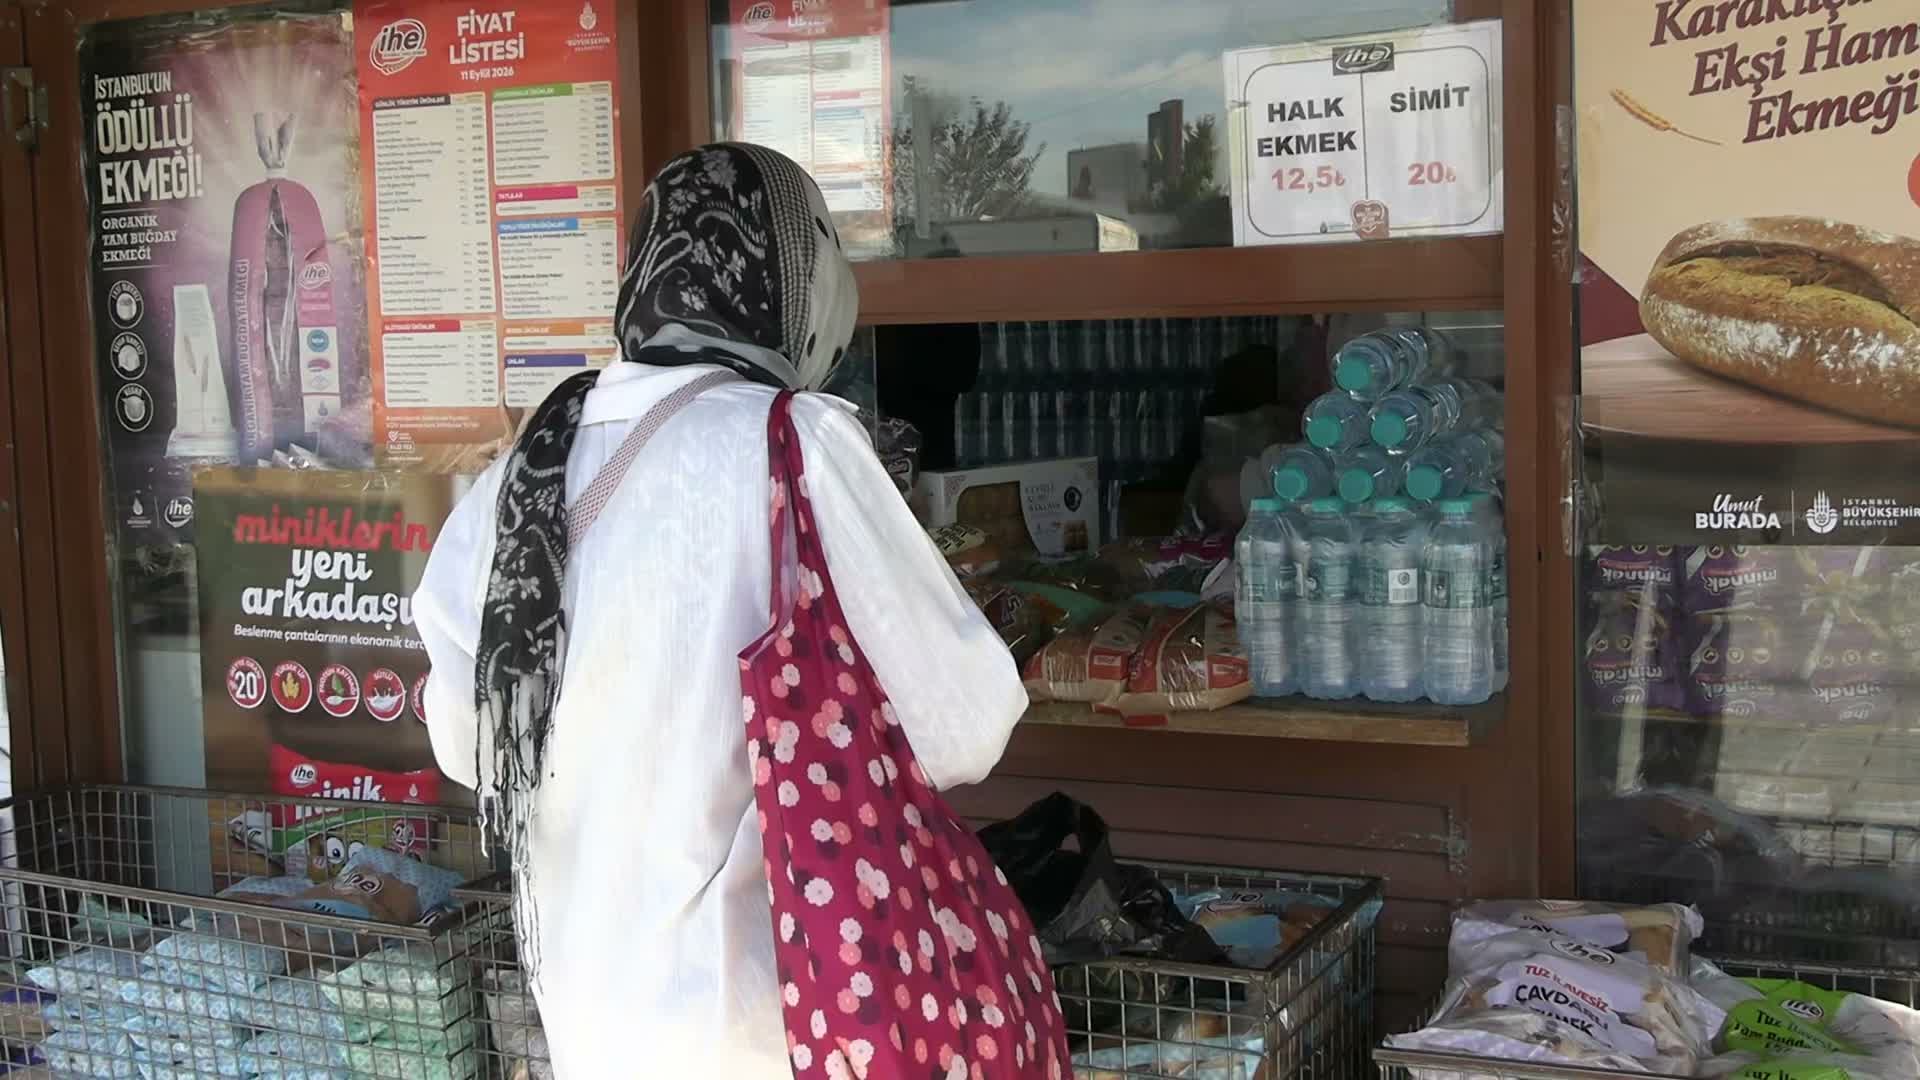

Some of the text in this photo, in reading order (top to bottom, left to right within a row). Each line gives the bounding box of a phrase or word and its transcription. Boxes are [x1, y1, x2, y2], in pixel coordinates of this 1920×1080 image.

[457, 8, 515, 37] FİYAT
[380, 26, 420, 51] ihe
[449, 31, 525, 65] LİSTESİ
[1344, 46, 1388, 62] ihe
[1689, 22, 1920, 97] Ekşi Ham
[94, 71, 172, 99] İSTANBUL'UN
[1267, 97, 1344, 122] HALK
[1390, 83, 1470, 113] SİMİT
[1742, 68, 1920, 144] Ekmeği
[97, 93, 193, 154] ÖDÜLLÜ
[1257, 130, 1357, 157] EKMEK
[101, 147, 203, 205] EKMEĞİ!
[102, 213, 158, 230] ORGANİK
[102, 229, 177, 245] TAM BUĞDAY
[103, 246, 151, 262] EKMEĞİ
[168, 501, 192, 516] ihe
[1713, 493, 1764, 513] Umut
[1843, 497, 1897, 506] İSTANBUL
[1843, 505, 1920, 518] BÜYÜKŞEHİR
[233, 504, 432, 552] miniklerin
[1695, 512, 1782, 530] BURADA
[1843, 519, 1897, 527] BELEDİYESİ
[292, 549, 374, 588] yeni
[234, 623, 283, 639] Beslenme
[284, 629, 348, 643] çantalarının
[350, 632, 402, 648] ekonomik
[294, 766, 314, 780] ihe
[1525, 964, 1551, 978] TUZ
[1757, 1008, 1783, 1027] Tuz
